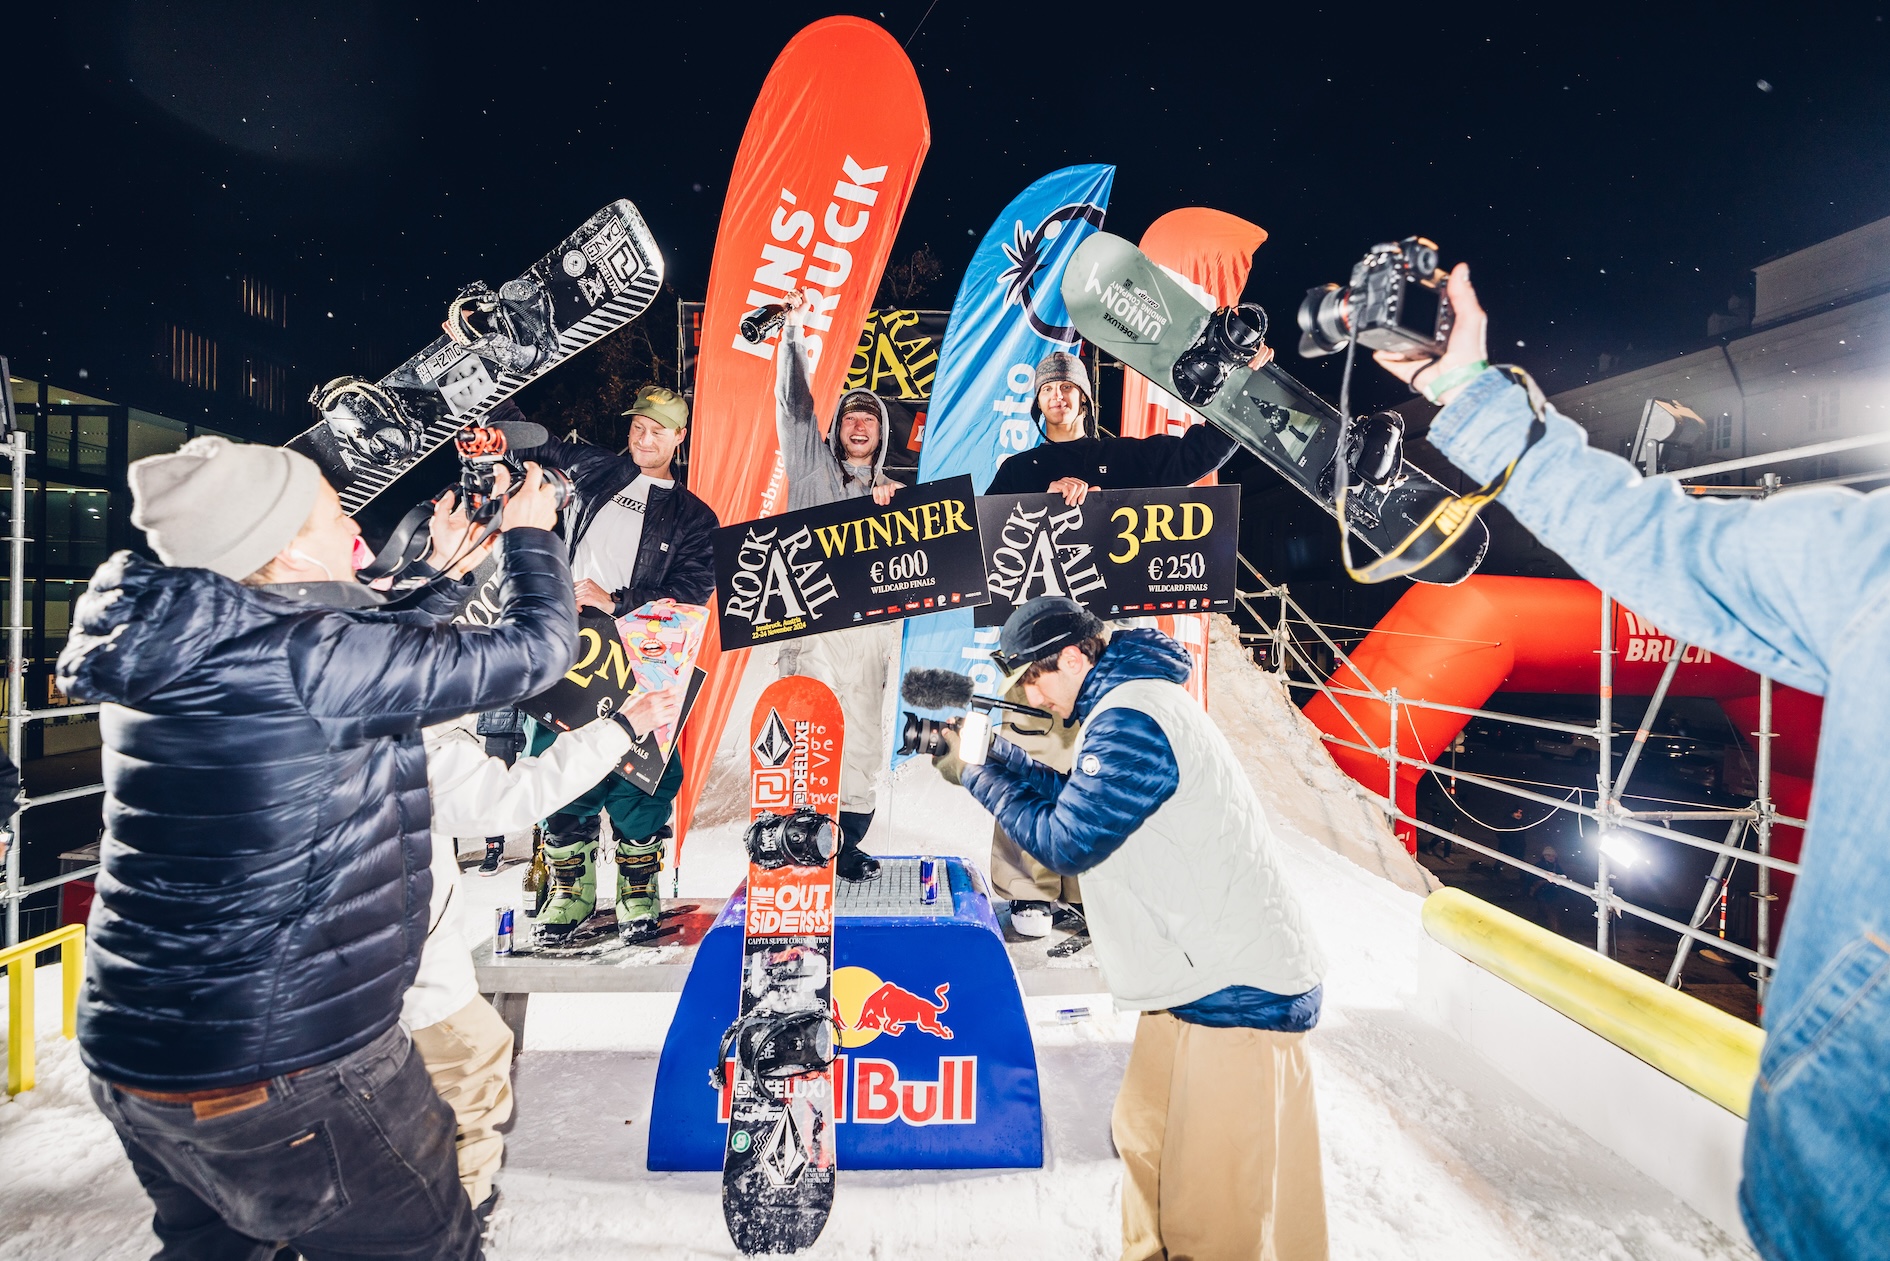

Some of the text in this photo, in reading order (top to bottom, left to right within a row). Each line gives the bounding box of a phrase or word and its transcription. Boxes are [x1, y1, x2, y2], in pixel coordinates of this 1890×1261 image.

[596, 259, 622, 297] DEELUXE
[1100, 285, 1162, 342] UNION
[1109, 280, 1168, 326] BINDING COMPANY
[1103, 312, 1136, 341] DEELUXE
[814, 499, 974, 559] WINNER
[988, 501, 1048, 601] ROCK
[1108, 502, 1214, 564] 3RD
[725, 526, 778, 622] ROCK
[777, 524, 840, 621] RAIL
[870, 549, 929, 584] € 600
[1048, 505, 1107, 607] RAIL
[1147, 551, 1206, 581] € 250
[870, 577, 936, 595] WILDCARD FINALS
[1148, 583, 1208, 593] WILDCARD FINALS
[564, 627, 639, 696] 2N
[794, 721, 810, 791] DEELUXE
[811, 736, 834, 751] be
[750, 884, 831, 911] THE OUT
[747, 937, 769, 945] CAPITA
[769, 937, 788, 945] SUPER
[748, 910, 815, 935] SIDERS
[857, 1058, 974, 1125] Bull
